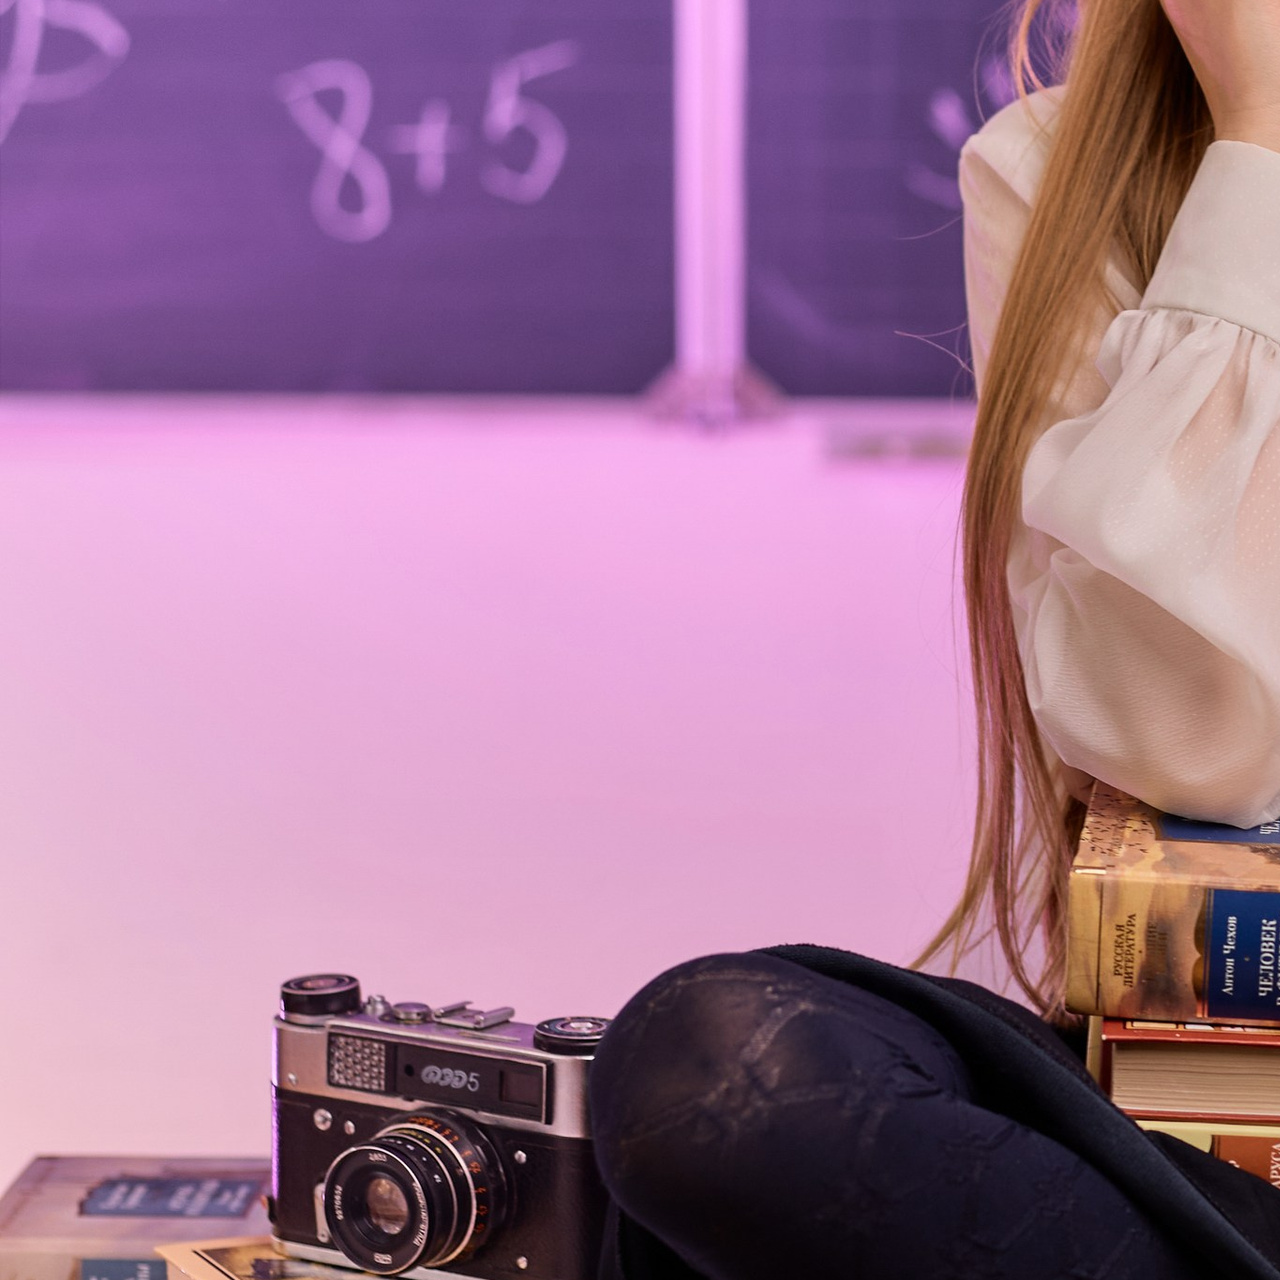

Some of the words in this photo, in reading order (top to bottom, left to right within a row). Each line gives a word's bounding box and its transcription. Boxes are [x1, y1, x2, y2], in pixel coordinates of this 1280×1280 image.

[1113, 924, 1125, 977] РУССКАЯ
[1123, 913, 1136, 988] ЛИТЕРАТУРА
[1222, 915, 1238, 956] Чехов
[1258, 918, 1278, 997] ЧЕЛОВЕК
[1221, 957, 1235, 995] Антон
